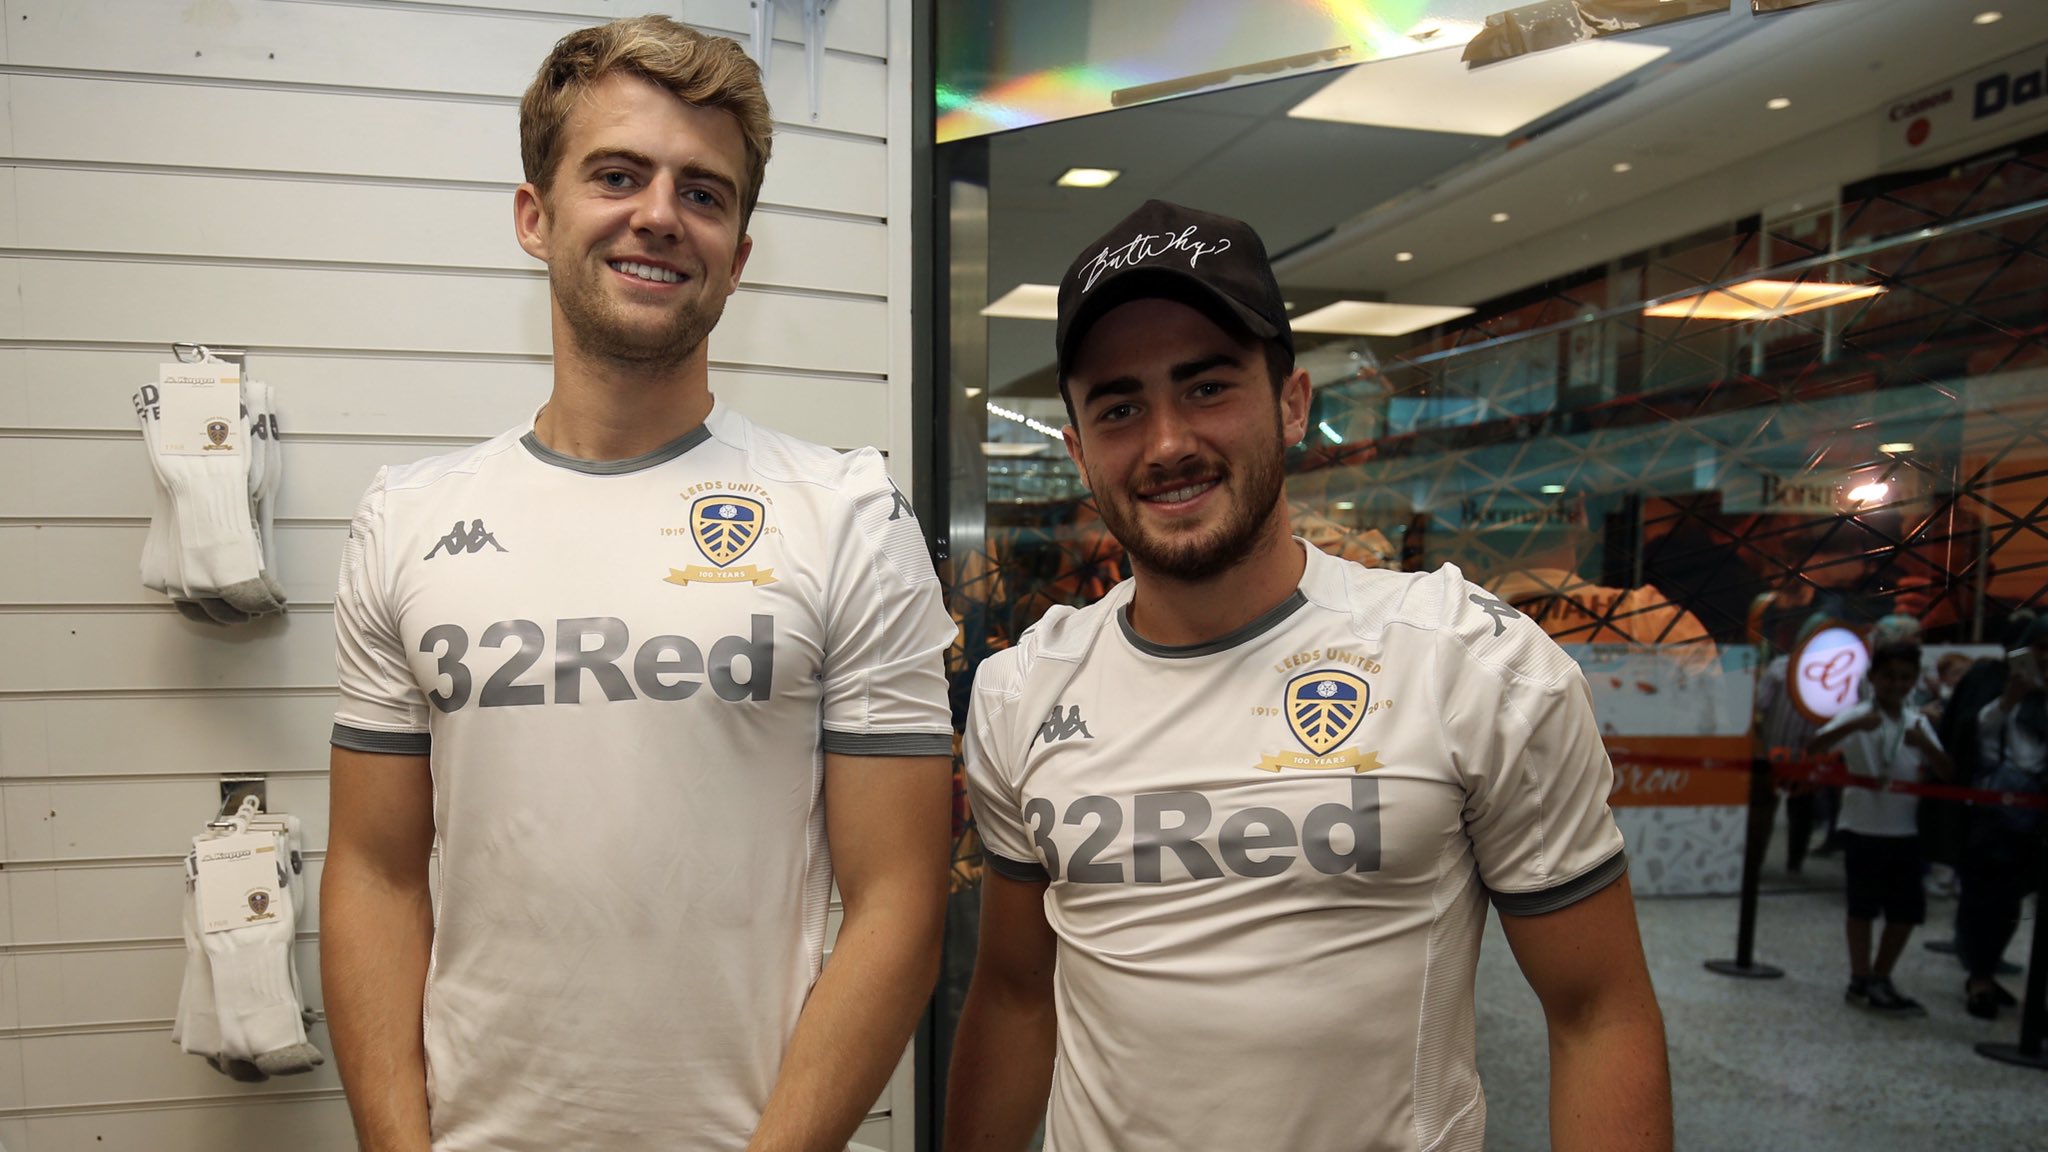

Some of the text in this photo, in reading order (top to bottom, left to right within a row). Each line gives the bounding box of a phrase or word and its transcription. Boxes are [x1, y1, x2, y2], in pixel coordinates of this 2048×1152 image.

[1973, 57, 2048, 120] Da
[680, 481, 773, 505] LEEDS UNITED
[660, 528, 685, 536] 1919
[419, 614, 774, 714] 32Red
[1274, 648, 1382, 674] LEEDS UNITED
[1251, 700, 1393, 717] 1919 2019
[1294, 756, 1346, 765] 100 YEARS
[1024, 775, 1381, 884] 32Red
